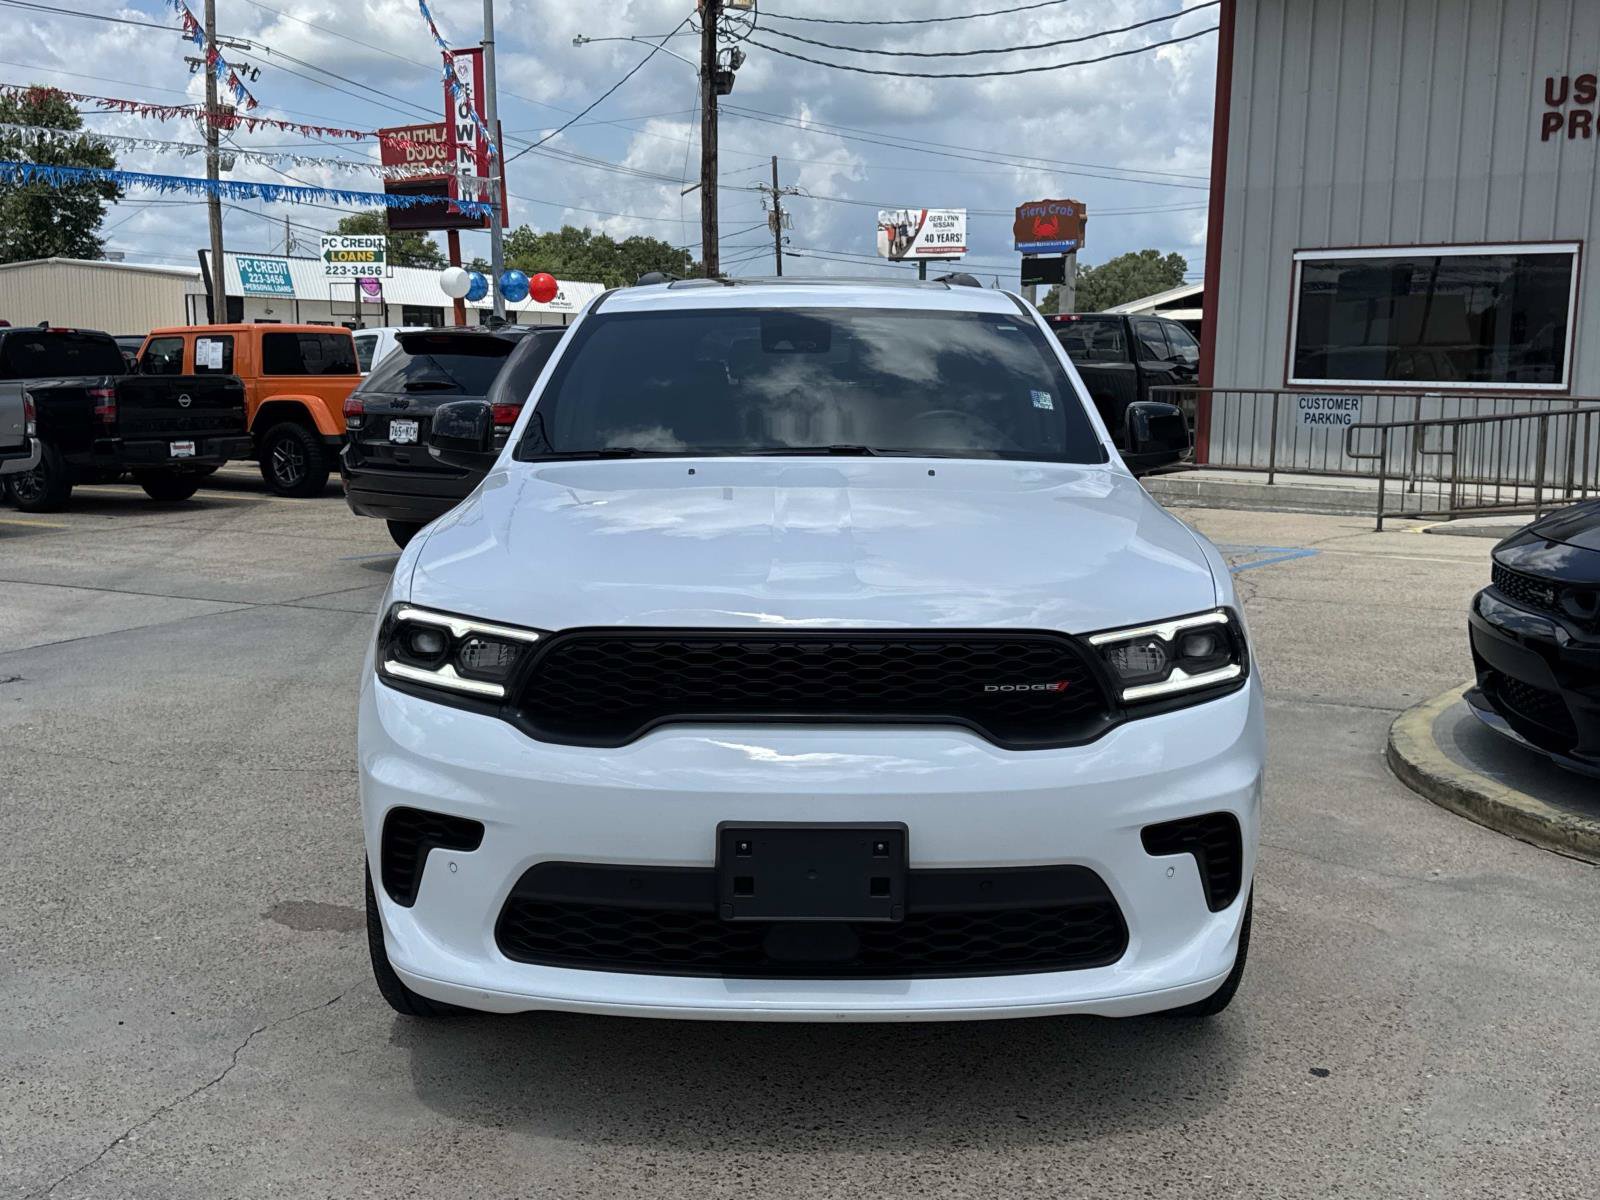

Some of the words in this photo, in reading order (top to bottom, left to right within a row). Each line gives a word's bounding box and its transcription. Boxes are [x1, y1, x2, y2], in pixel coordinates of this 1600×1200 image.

[1541, 109, 1600, 142] PR
[406, 145, 448, 161] DODG
[322, 238, 338, 249] PC
[341, 238, 384, 250] CREDIT
[925, 233, 935, 243] 40
[331, 251, 375, 262] LOANS
[238, 259, 253, 272] PC
[253, 260, 288, 275] CREDIT
[325, 265, 383, 276] 223-3456
[248, 273, 285, 285] 223-3456
[1299, 397, 1359, 411] CUSTOMER
[1304, 412, 1352, 425] PARKING
[984, 682, 1060, 692] DODGE
